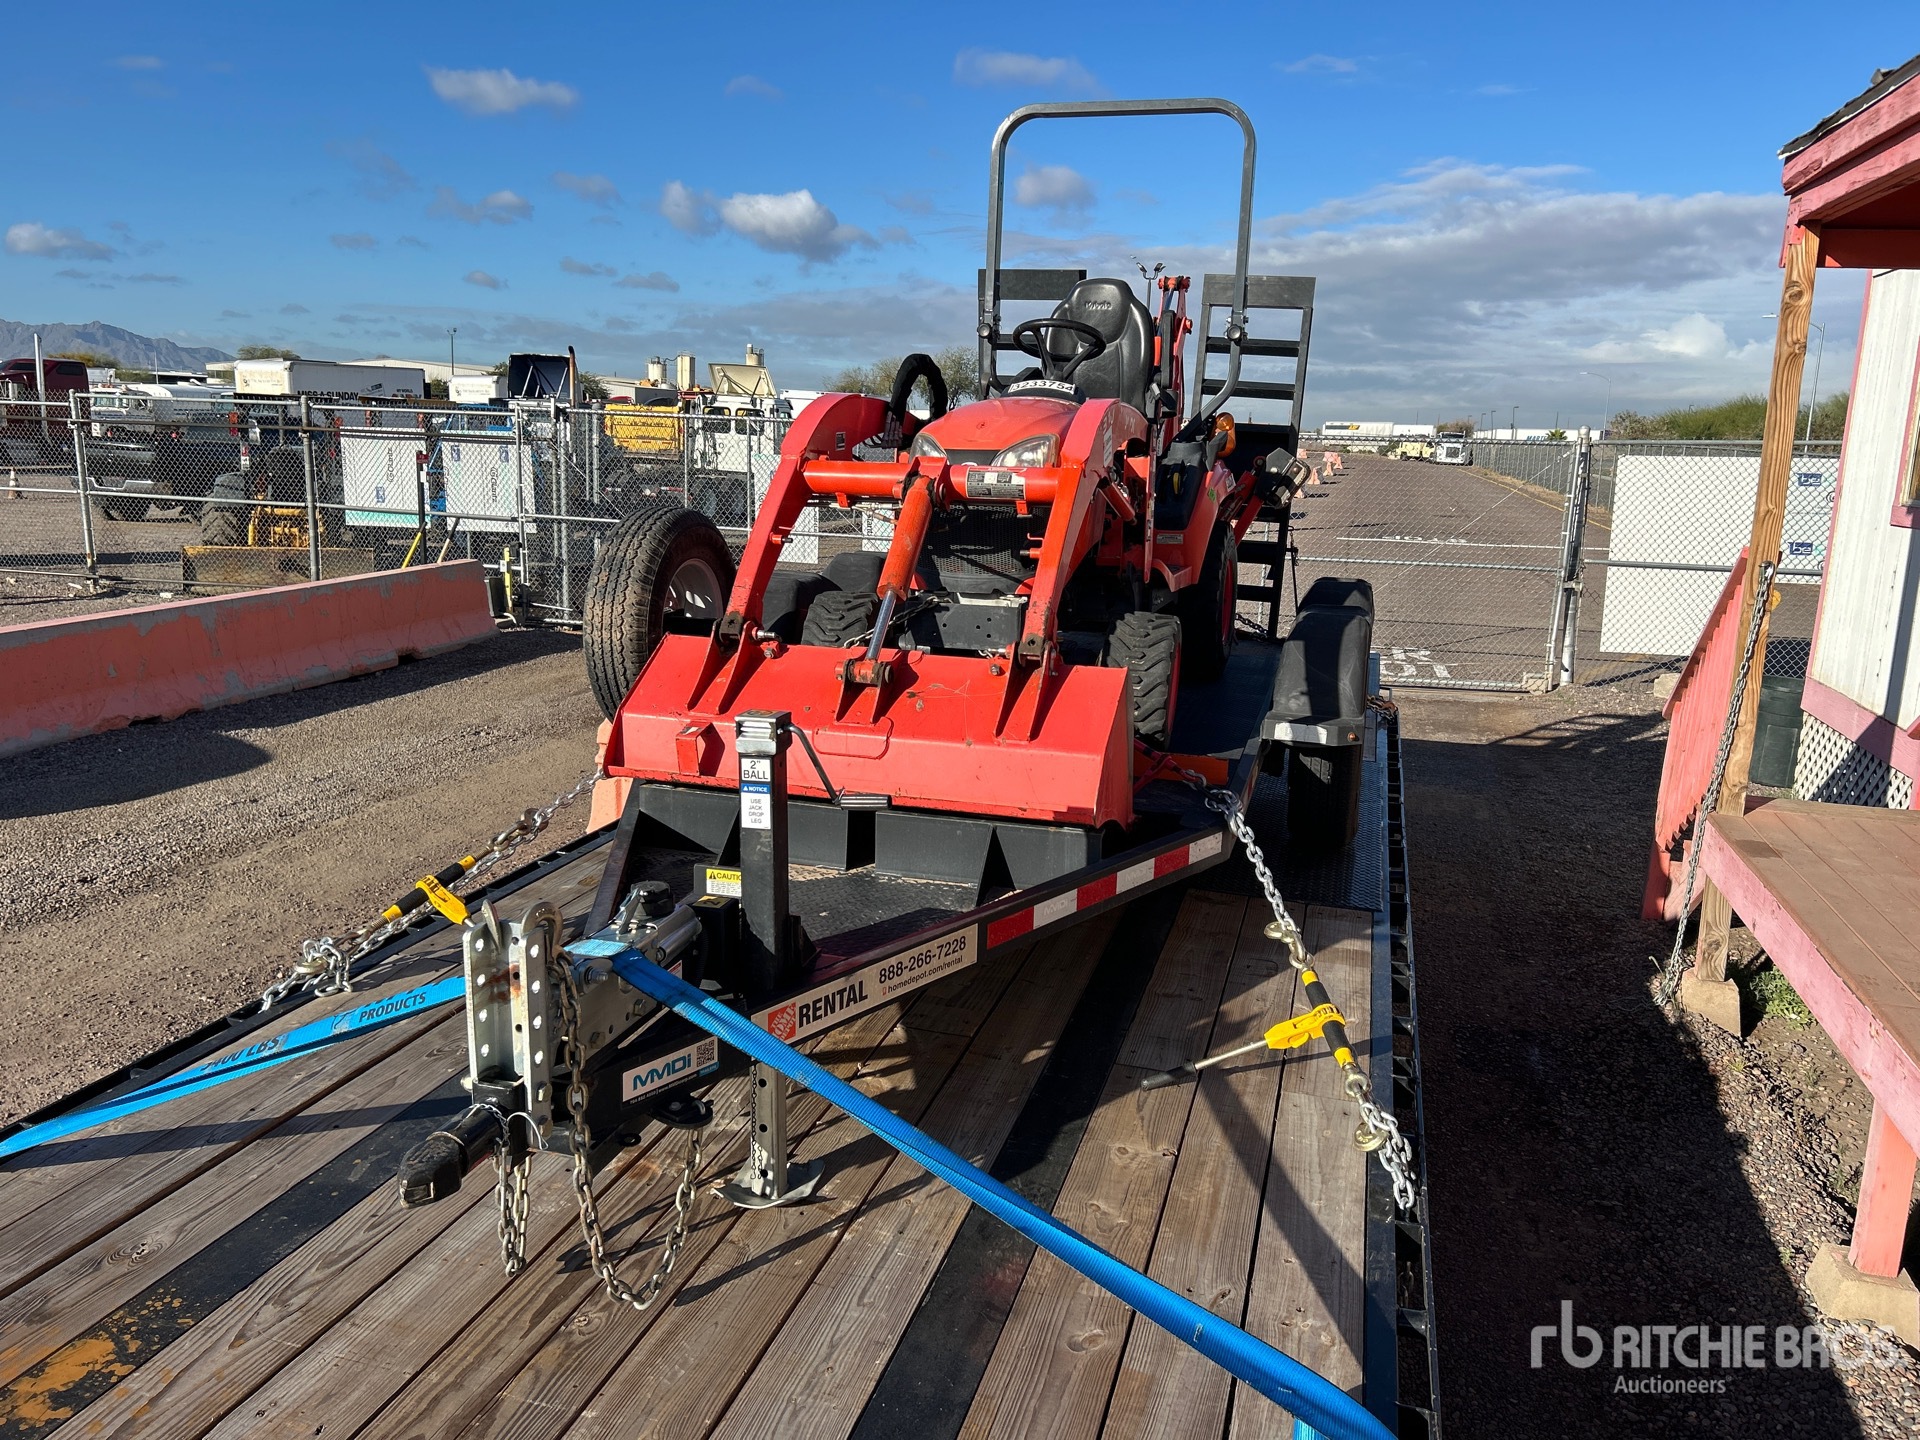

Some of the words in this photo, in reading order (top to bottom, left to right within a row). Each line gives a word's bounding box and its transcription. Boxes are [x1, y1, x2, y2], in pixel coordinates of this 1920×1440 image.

[743, 769, 769, 780] BALL
[750, 760, 761, 770] 2"
[748, 785, 768, 793] NOTICE
[878, 935, 967, 984] 888-266-7228
[887, 954, 963, 994] homedepot.com/rental
[358, 991, 427, 1023] PRODUCTS
[798, 979, 869, 1029] RENTAL
[771, 1011, 783, 1028] THE
[246, 1037, 281, 1057] LBS
[632, 1053, 692, 1092] MMDi
